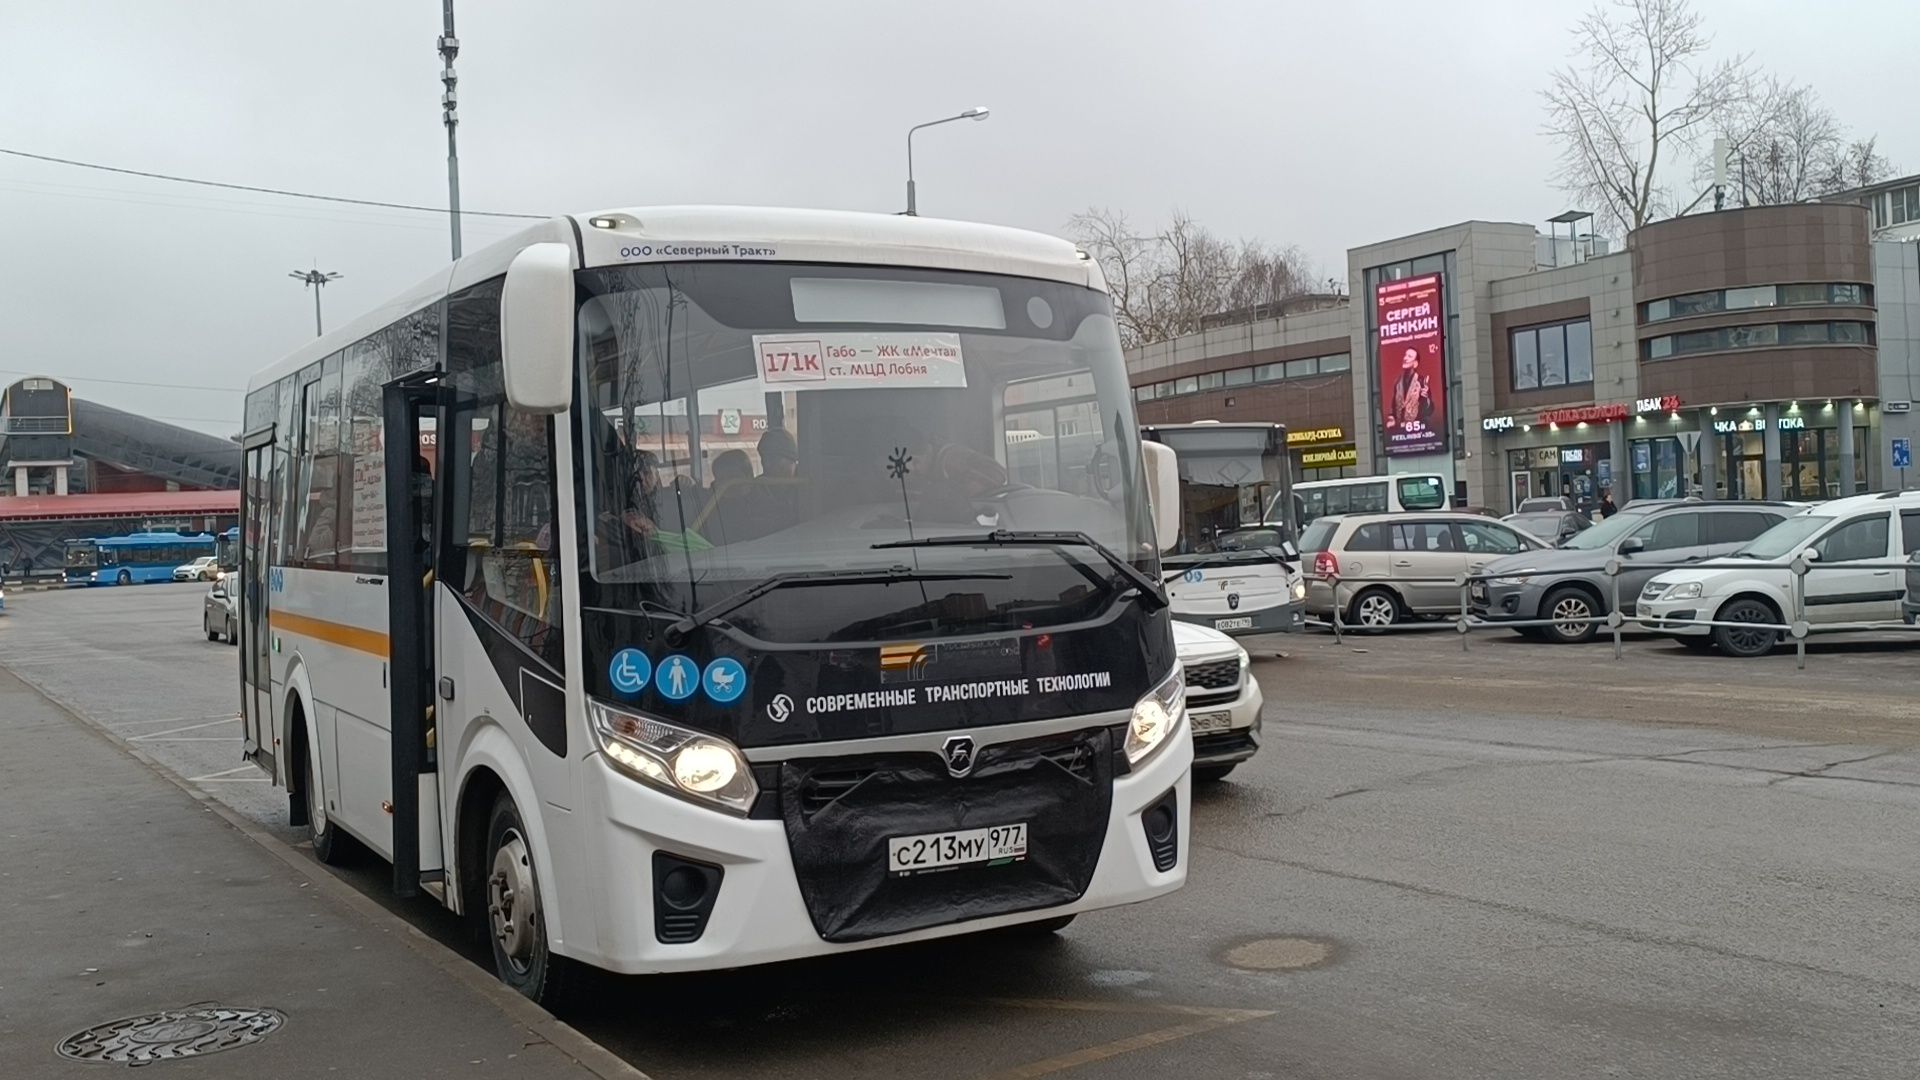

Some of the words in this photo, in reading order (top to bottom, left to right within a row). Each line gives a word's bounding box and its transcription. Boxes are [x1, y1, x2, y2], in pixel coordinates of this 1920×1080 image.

[620, 245, 652, 257] ООО
[655, 244, 730, 257] «Северный
[733, 245, 776, 257] Тракт»
[1386, 302, 1430, 322] СЕРГЕЙ
[1380, 316, 1438, 337] ПЕНКИН
[826, 345, 857, 358] Габо
[877, 345, 900, 357] ЖК
[902, 344, 957, 357] «Мечта»
[829, 366, 847, 376] ст.
[850, 364, 886, 377] МЦД
[889, 363, 928, 375] Лобня
[1636, 396, 1662, 412] ТАБАК
[1483, 416, 1514, 430] САМСА
[806, 688, 916, 714] СОВРЕМЕННЫЕ
[924, 678, 1030, 703] ТРАНСПОРТНЫЕ
[1036, 671, 1111, 693] ТЕХНОЛОГИИ
[896, 835, 985, 866] С213МУ
[990, 826, 1021, 848] 977
